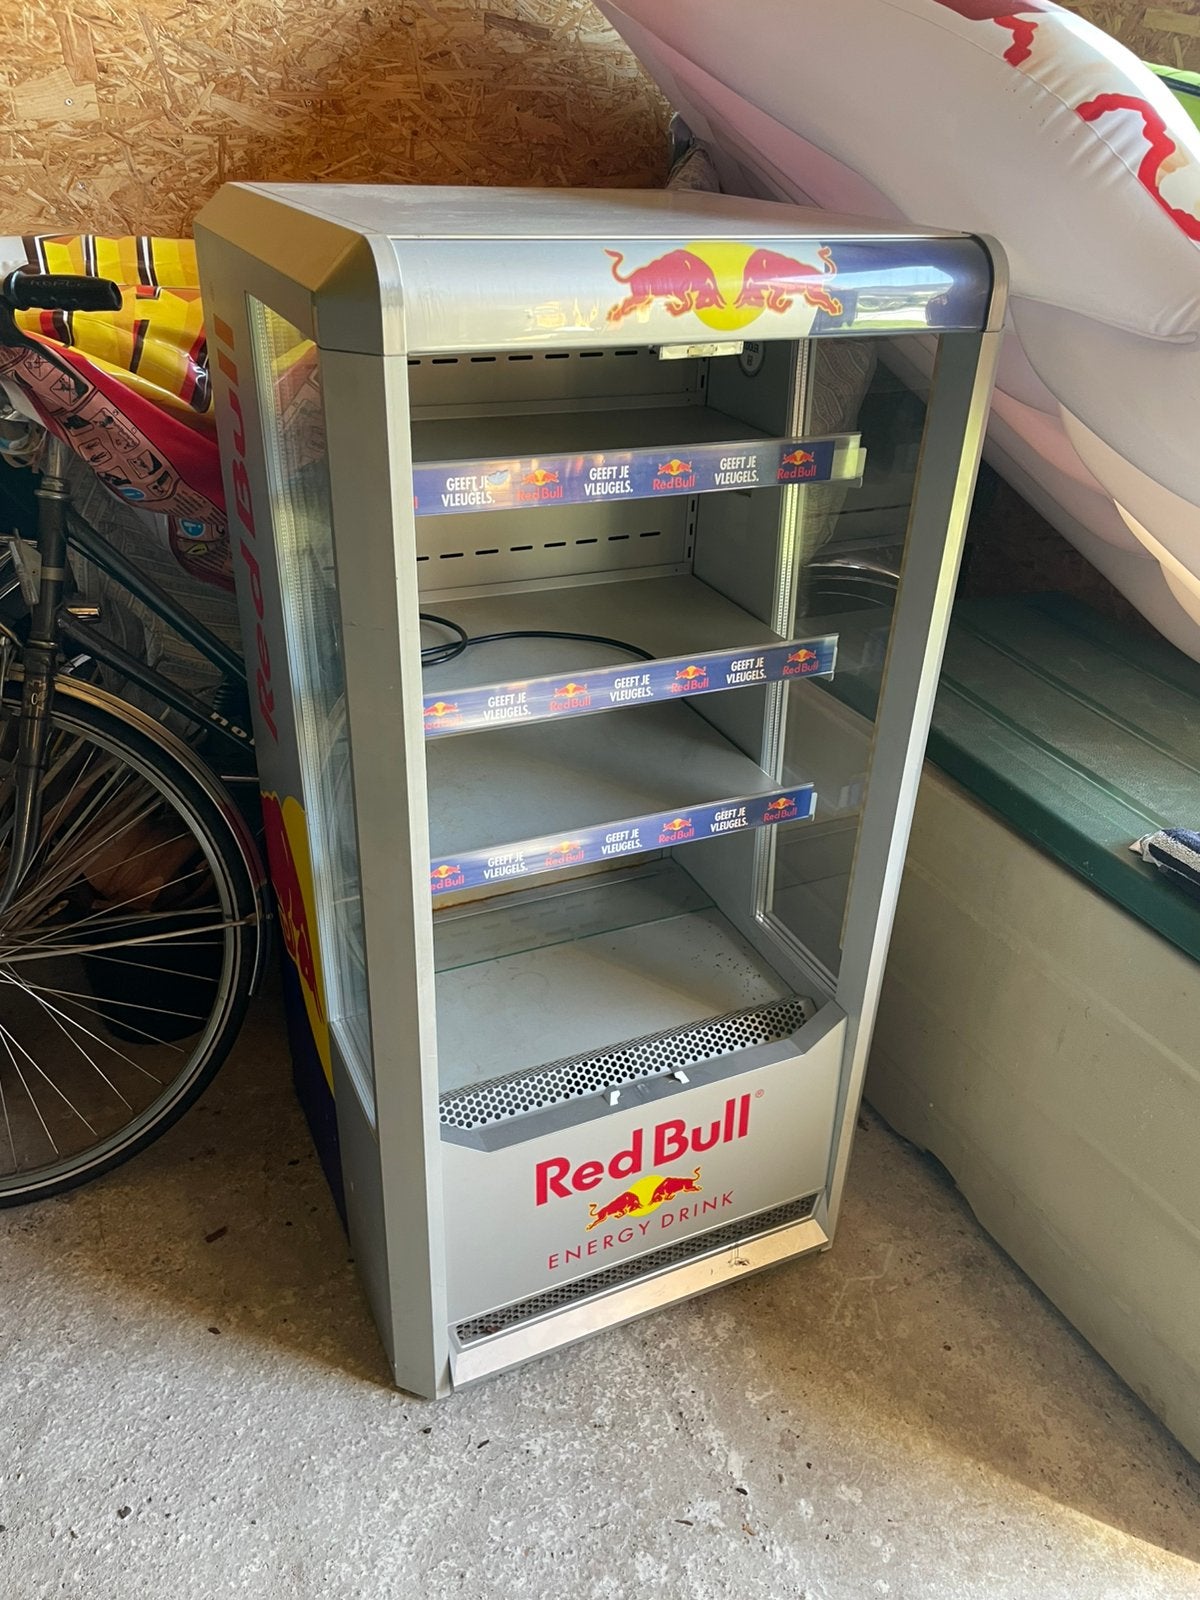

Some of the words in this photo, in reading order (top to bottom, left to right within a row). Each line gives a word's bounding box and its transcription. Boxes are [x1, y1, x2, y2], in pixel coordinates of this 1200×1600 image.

[213, 313, 255, 539] Bull
[720, 456, 746, 471] GEEFT
[746, 455, 757, 468] JE
[589, 466, 617, 481] GEEFT
[619, 465, 629, 479] JE
[714, 470, 759, 485] VLEUGELS.
[776, 467, 797, 480] Red
[797, 465, 817, 477] Bull
[446, 476, 477, 491] GEEFT
[584, 480, 634, 496] VLEUGELS.
[652, 477, 674, 490] Red
[675, 475, 696, 488] Bull
[441, 491, 496, 507] VLEUGELS.
[517, 486, 540, 502] Red
[542, 486, 563, 499] Bull
[241, 540, 278, 744] Red
[731, 658, 754, 672] GEEFT
[755, 657, 764, 668] JE
[782, 663, 801, 676] Red
[801, 660, 819, 672] Bull
[614, 676, 640, 689] GEEFT
[641, 674, 650, 686] JE
[726, 669, 767, 684] VLEUGELS.
[671, 680, 691, 694] Red
[691, 678, 710, 690] Bull
[488, 694, 515, 708] GEEFT
[517, 692, 526, 704] JE
[610, 687, 654, 702] VLEUGELS.
[549, 698, 570, 711] Red
[572, 695, 591, 708] Bull
[483, 705, 531, 721] VLEUGELS.
[714, 810, 737, 822] GEEFT
[737, 807, 747, 817] JE
[763, 810, 781, 822] Red
[781, 807, 798, 818] Bull
[710, 817, 749, 833] VLEUGELS.
[605, 831, 631, 843] GEEFT
[631, 828, 640, 838] JE
[659, 831, 677, 844] Red
[677, 828, 695, 840] Bull
[601, 839, 642, 855] VLEUGELS.
[487, 855, 512, 867] GEEFT
[514, 851, 524, 863] JE
[544, 855, 565, 867] Red
[565, 851, 585, 863] Bull
[483, 862, 528, 880] VLEUGELS.
[430, 880, 444, 891] ed
[444, 874, 465, 888] Bull
[535, 1128, 643, 1206] Red
[653, 1093, 751, 1167] Bull
[549, 1221, 650, 1270] ENERGY
[661, 1190, 734, 1228] DRINK
